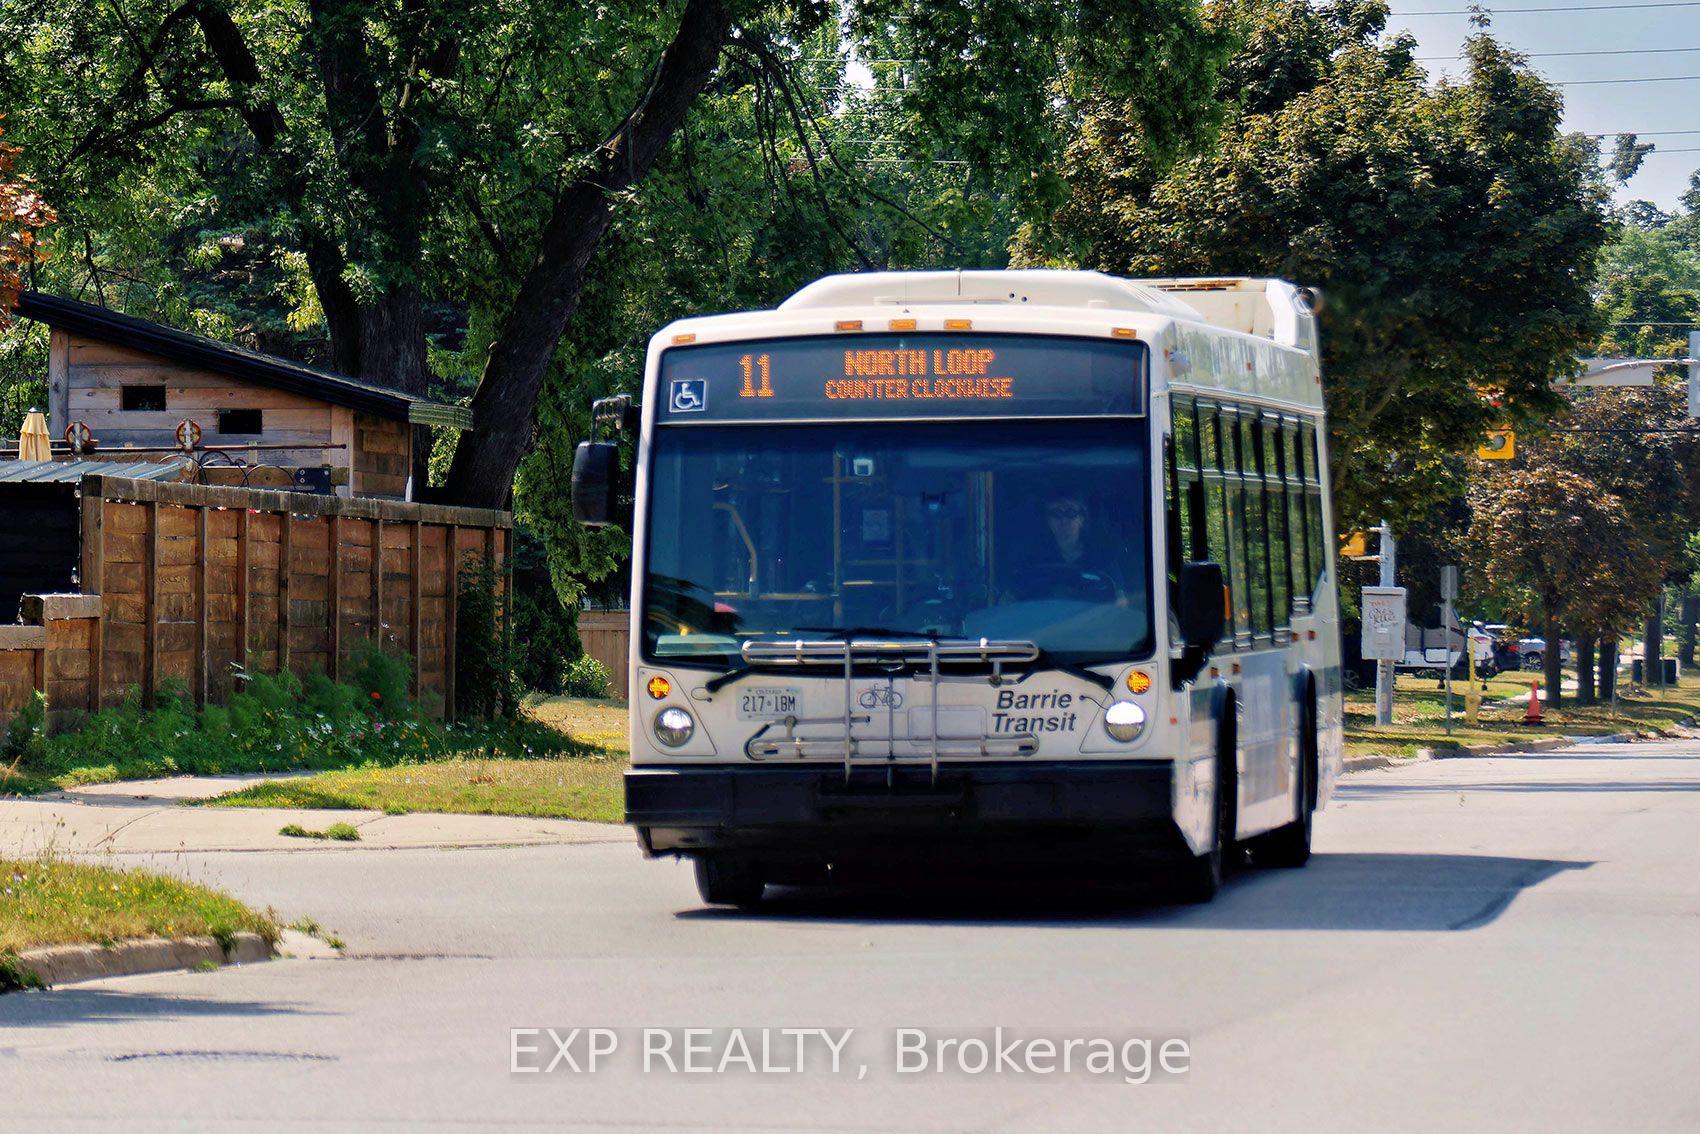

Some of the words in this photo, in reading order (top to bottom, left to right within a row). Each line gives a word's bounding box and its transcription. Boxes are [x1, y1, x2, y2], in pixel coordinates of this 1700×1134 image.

[844, 349, 927, 376] NORTH
[933, 349, 995, 375] LOOP
[739, 354, 774, 397] 11
[825, 378, 909, 399] COUNTER
[911, 377, 1014, 399] CLOCKWISE
[996, 689, 1072, 710] Barrie
[992, 712, 1077, 733] Transit
